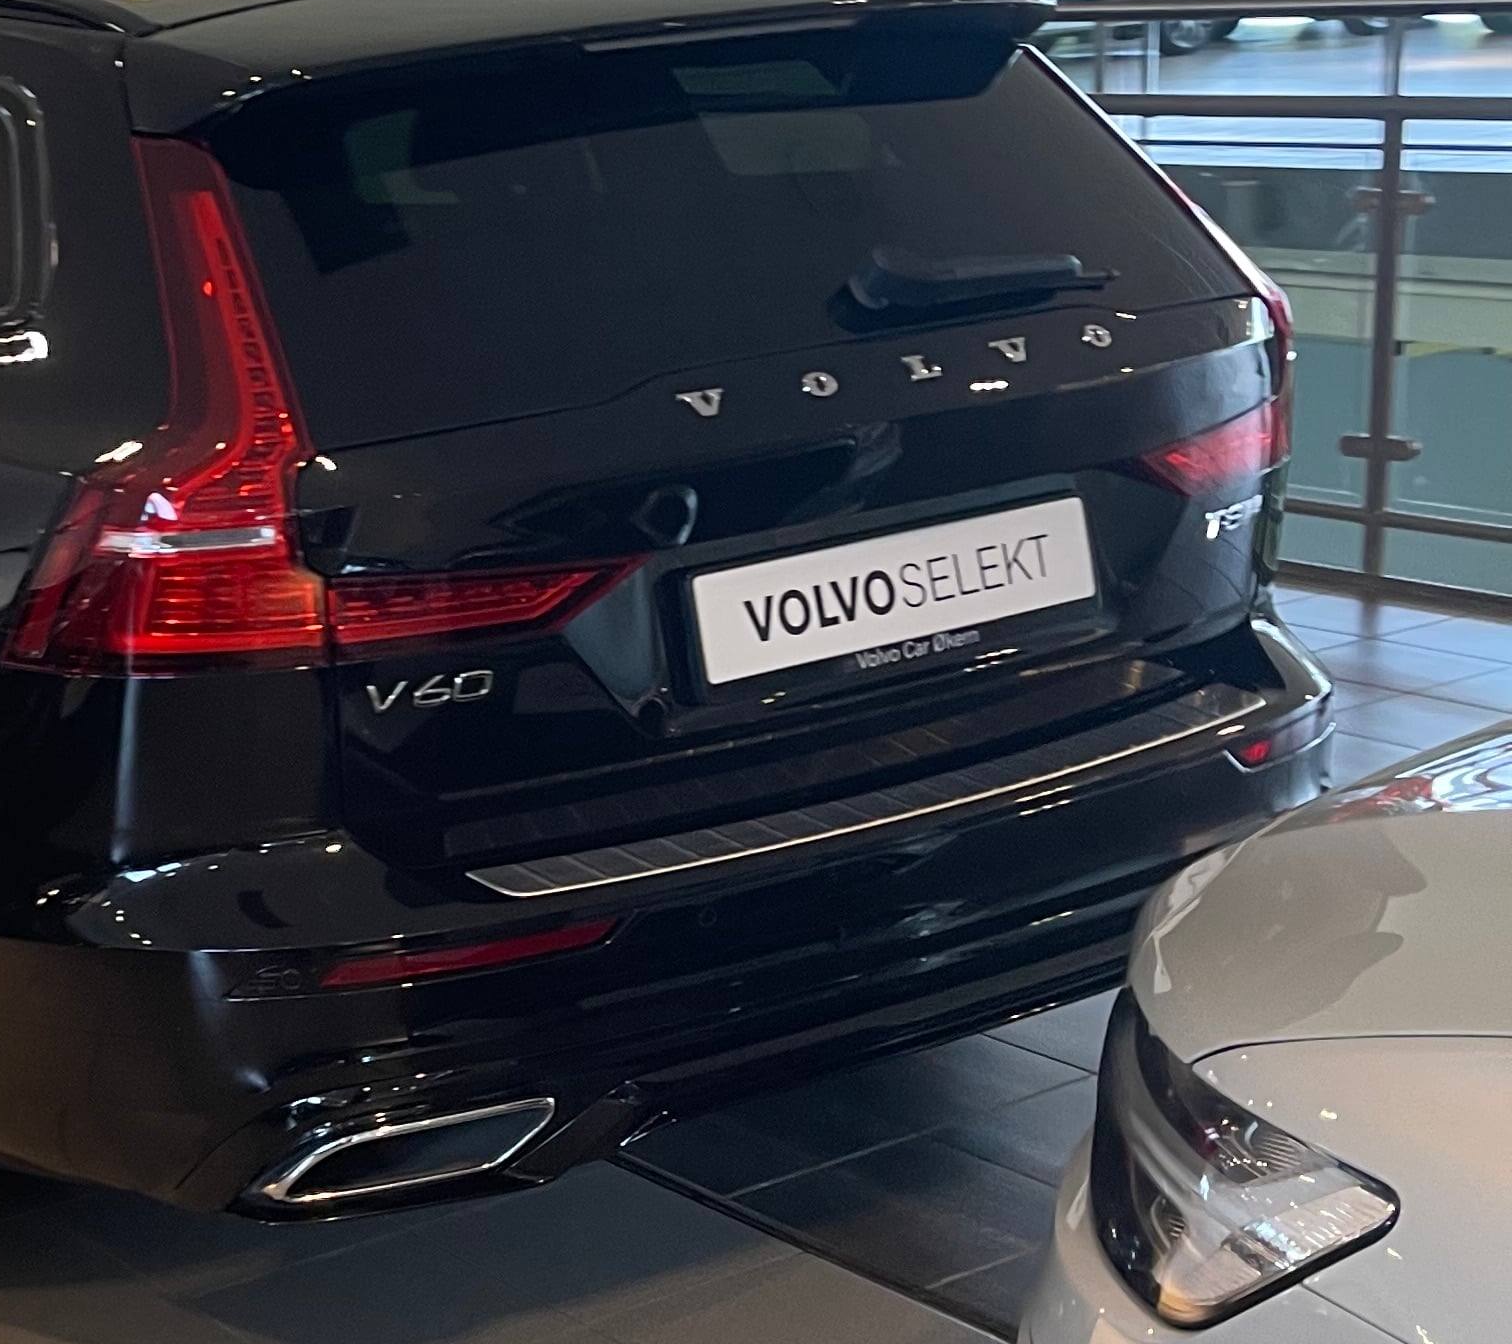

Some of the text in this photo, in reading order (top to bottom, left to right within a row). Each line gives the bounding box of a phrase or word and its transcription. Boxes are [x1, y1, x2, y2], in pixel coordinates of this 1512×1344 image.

[674, 323, 1113, 418] VOLVO
[855, 647, 902, 670] Volvo
[902, 640, 931, 659] Car
[365, 669, 495, 714] V60
